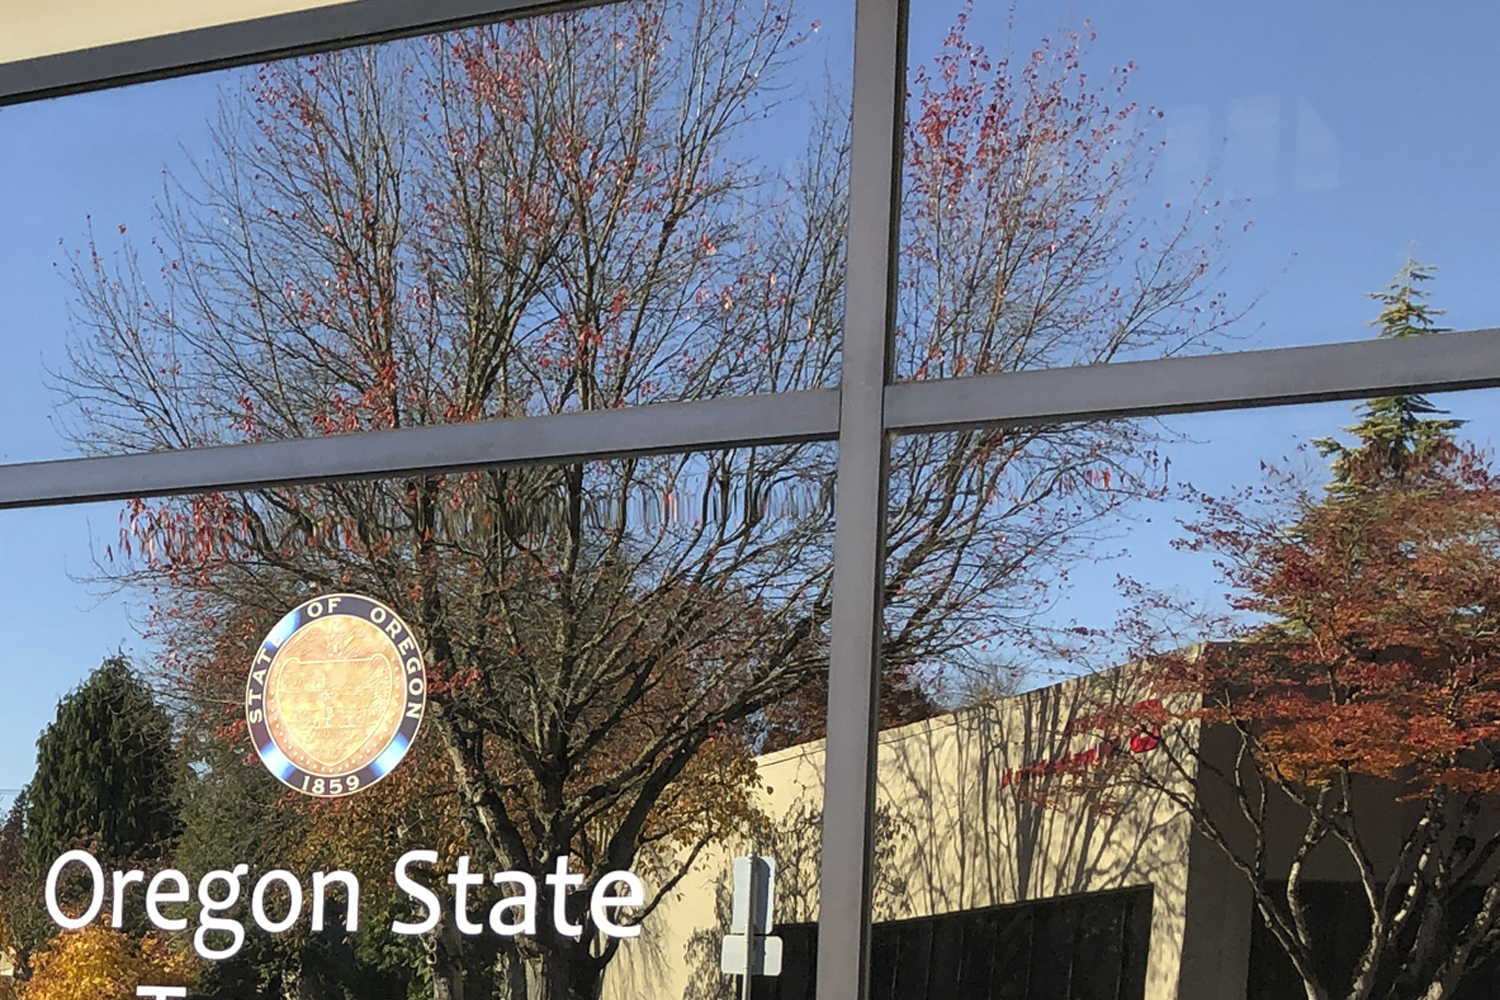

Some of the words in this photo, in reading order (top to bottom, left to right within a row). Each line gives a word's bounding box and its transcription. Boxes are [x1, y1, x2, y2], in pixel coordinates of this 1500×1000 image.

[307, 597, 341, 618] OF
[370, 607, 425, 719] OREGON
[301, 775, 359, 794] 1859
[45, 849, 359, 960] Oregon
[392, 850, 645, 938] State
